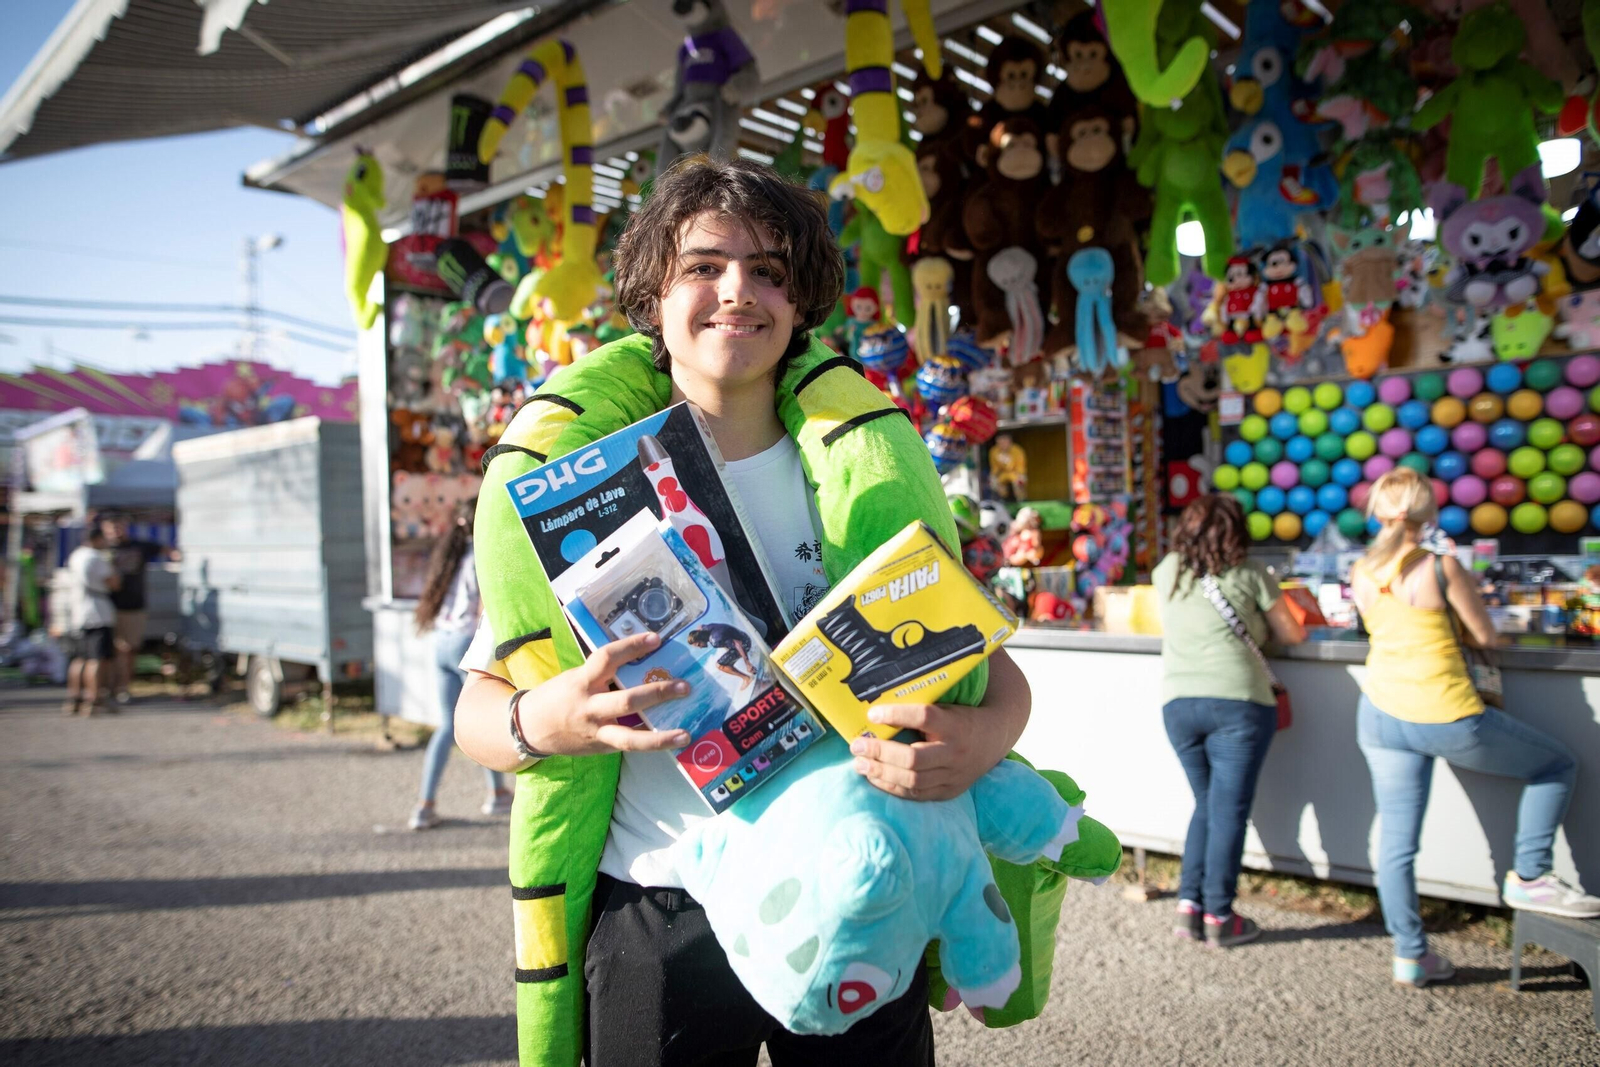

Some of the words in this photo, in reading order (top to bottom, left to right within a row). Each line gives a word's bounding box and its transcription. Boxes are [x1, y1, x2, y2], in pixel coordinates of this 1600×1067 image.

[515, 448, 607, 505] DHG
[540, 505, 585, 533] Lámpara
[585, 497, 599, 512] de
[599, 486, 625, 504] Lava
[598, 503, 618, 518] L-312
[887, 560, 940, 603] PAIFA
[728, 687, 785, 734] SPORTS
[707, 748, 716, 758] HD
[741, 730, 764, 749] Cam
